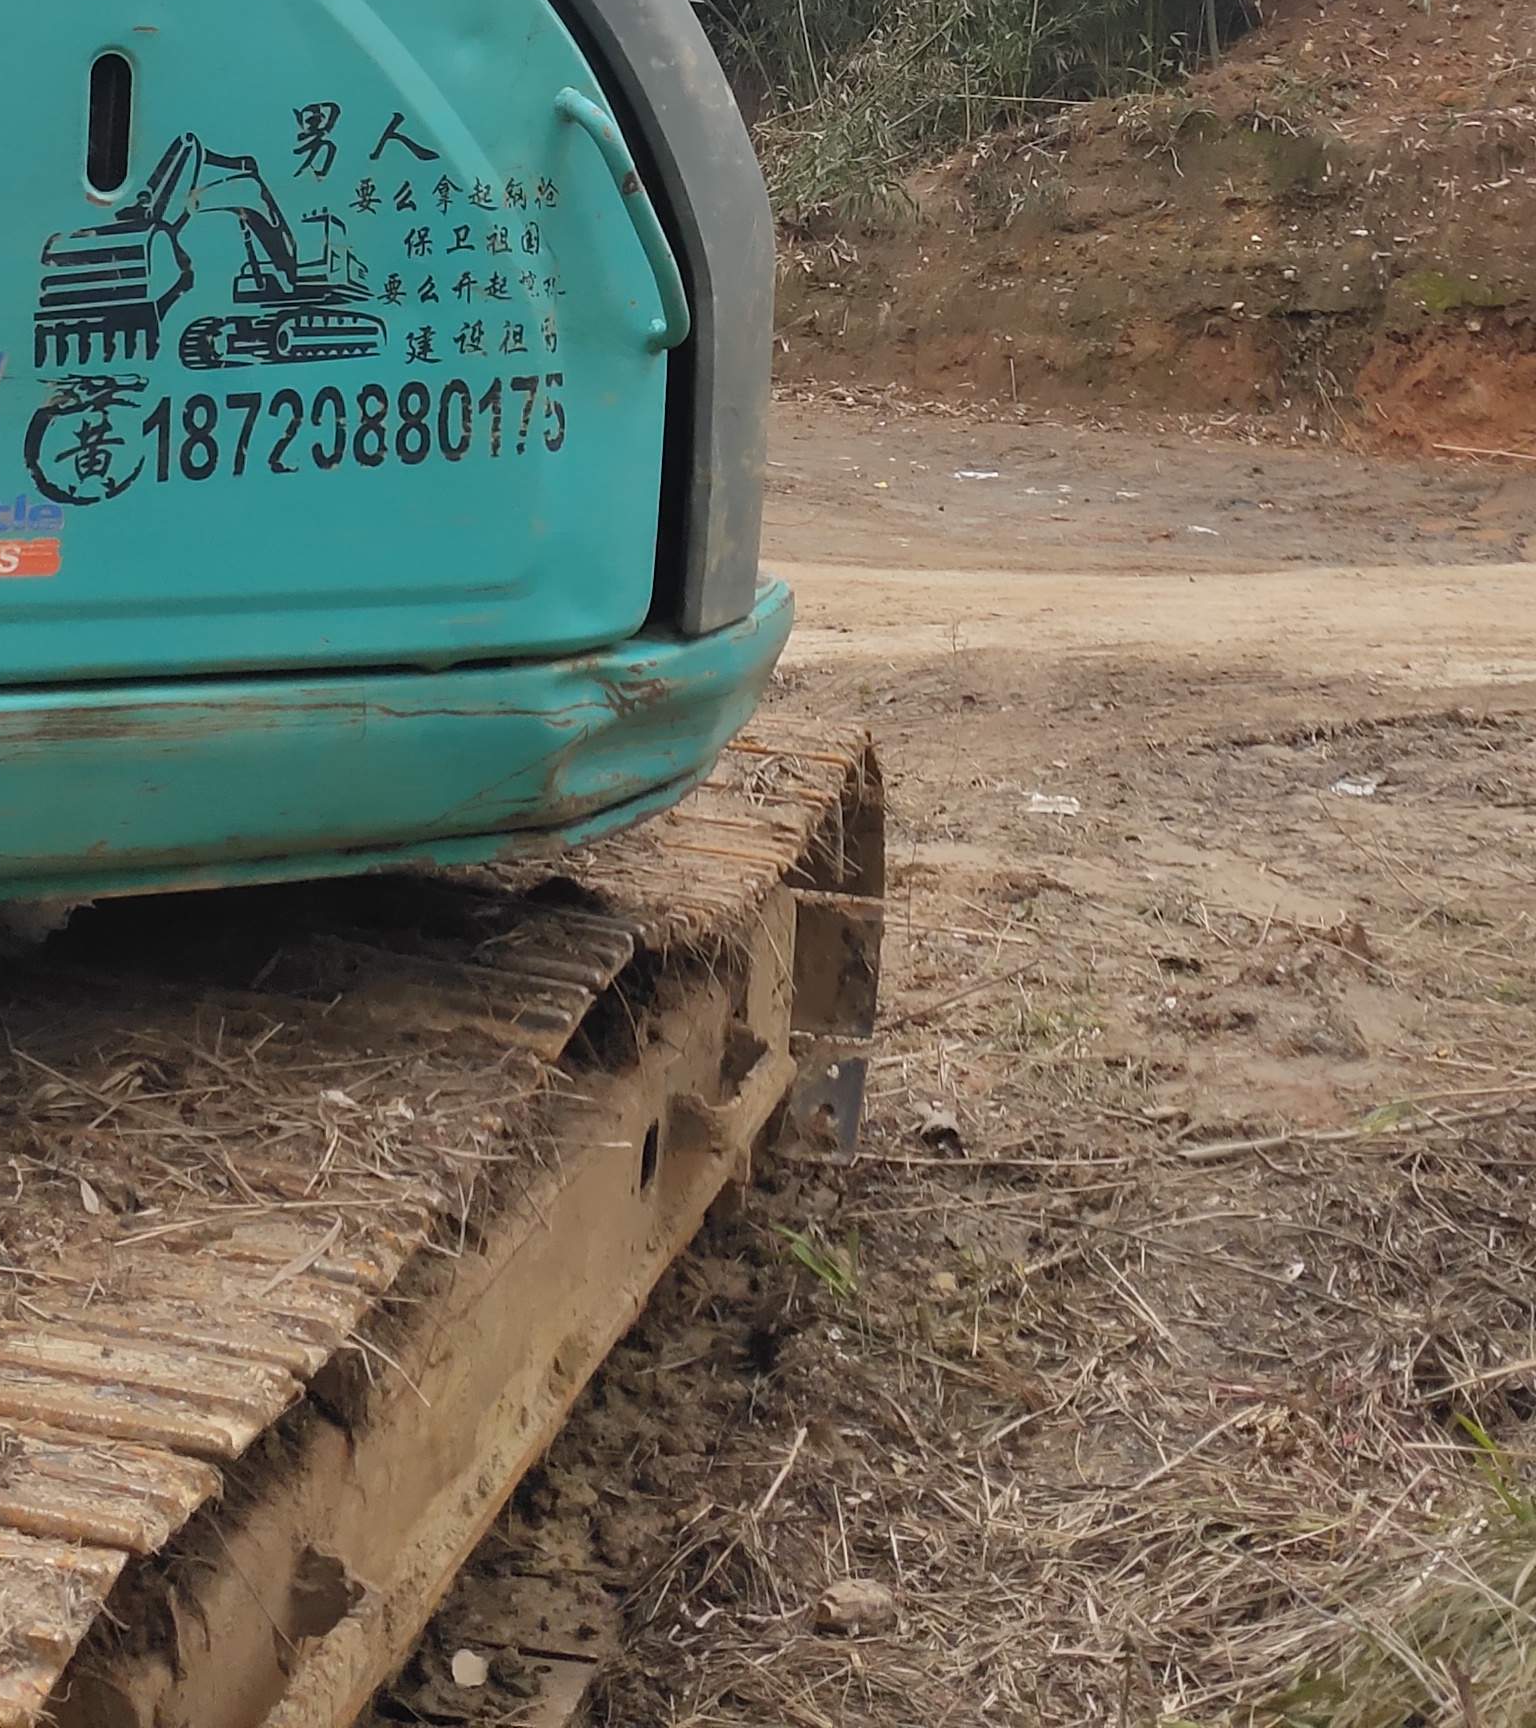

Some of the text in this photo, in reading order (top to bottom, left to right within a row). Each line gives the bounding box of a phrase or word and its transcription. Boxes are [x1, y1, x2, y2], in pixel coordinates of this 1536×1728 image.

[291, 101, 441, 182] 男人
[403, 222, 541, 259] 保卫祖国
